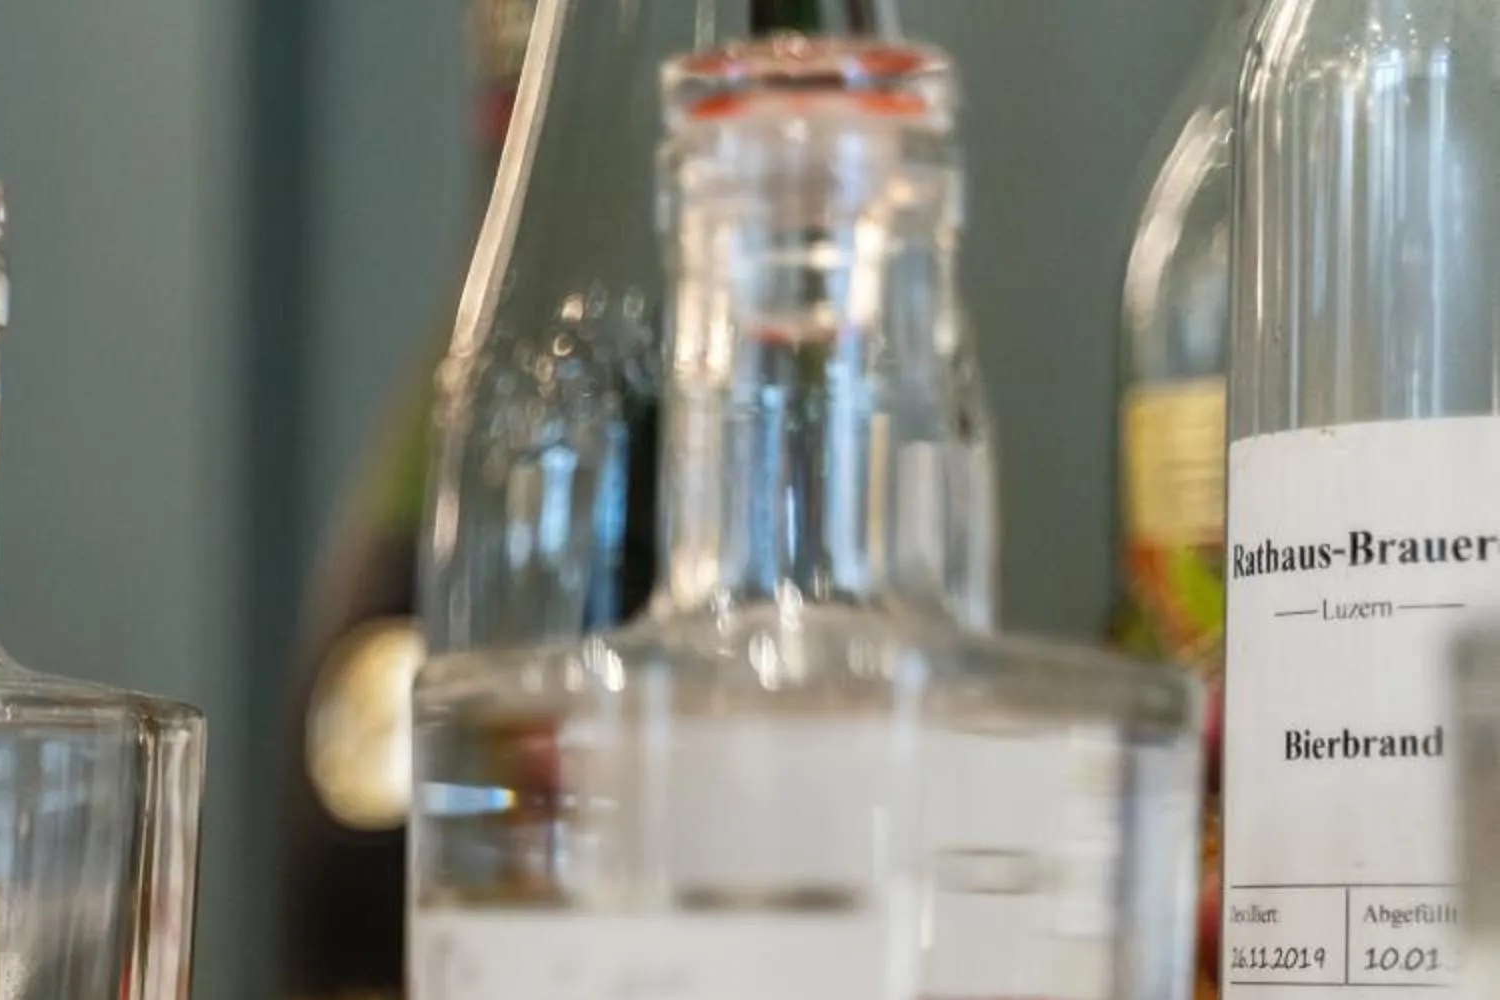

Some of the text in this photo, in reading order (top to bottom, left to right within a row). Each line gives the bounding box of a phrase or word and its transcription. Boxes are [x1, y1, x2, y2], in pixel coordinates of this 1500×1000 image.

[1233, 530, 1500, 579] Rathaus-Brauer
[1322, 599, 1393, 621] Luzern
[1284, 726, 1445, 761] Bierbrand
[1363, 904, 1458, 928] Abgefüllt
